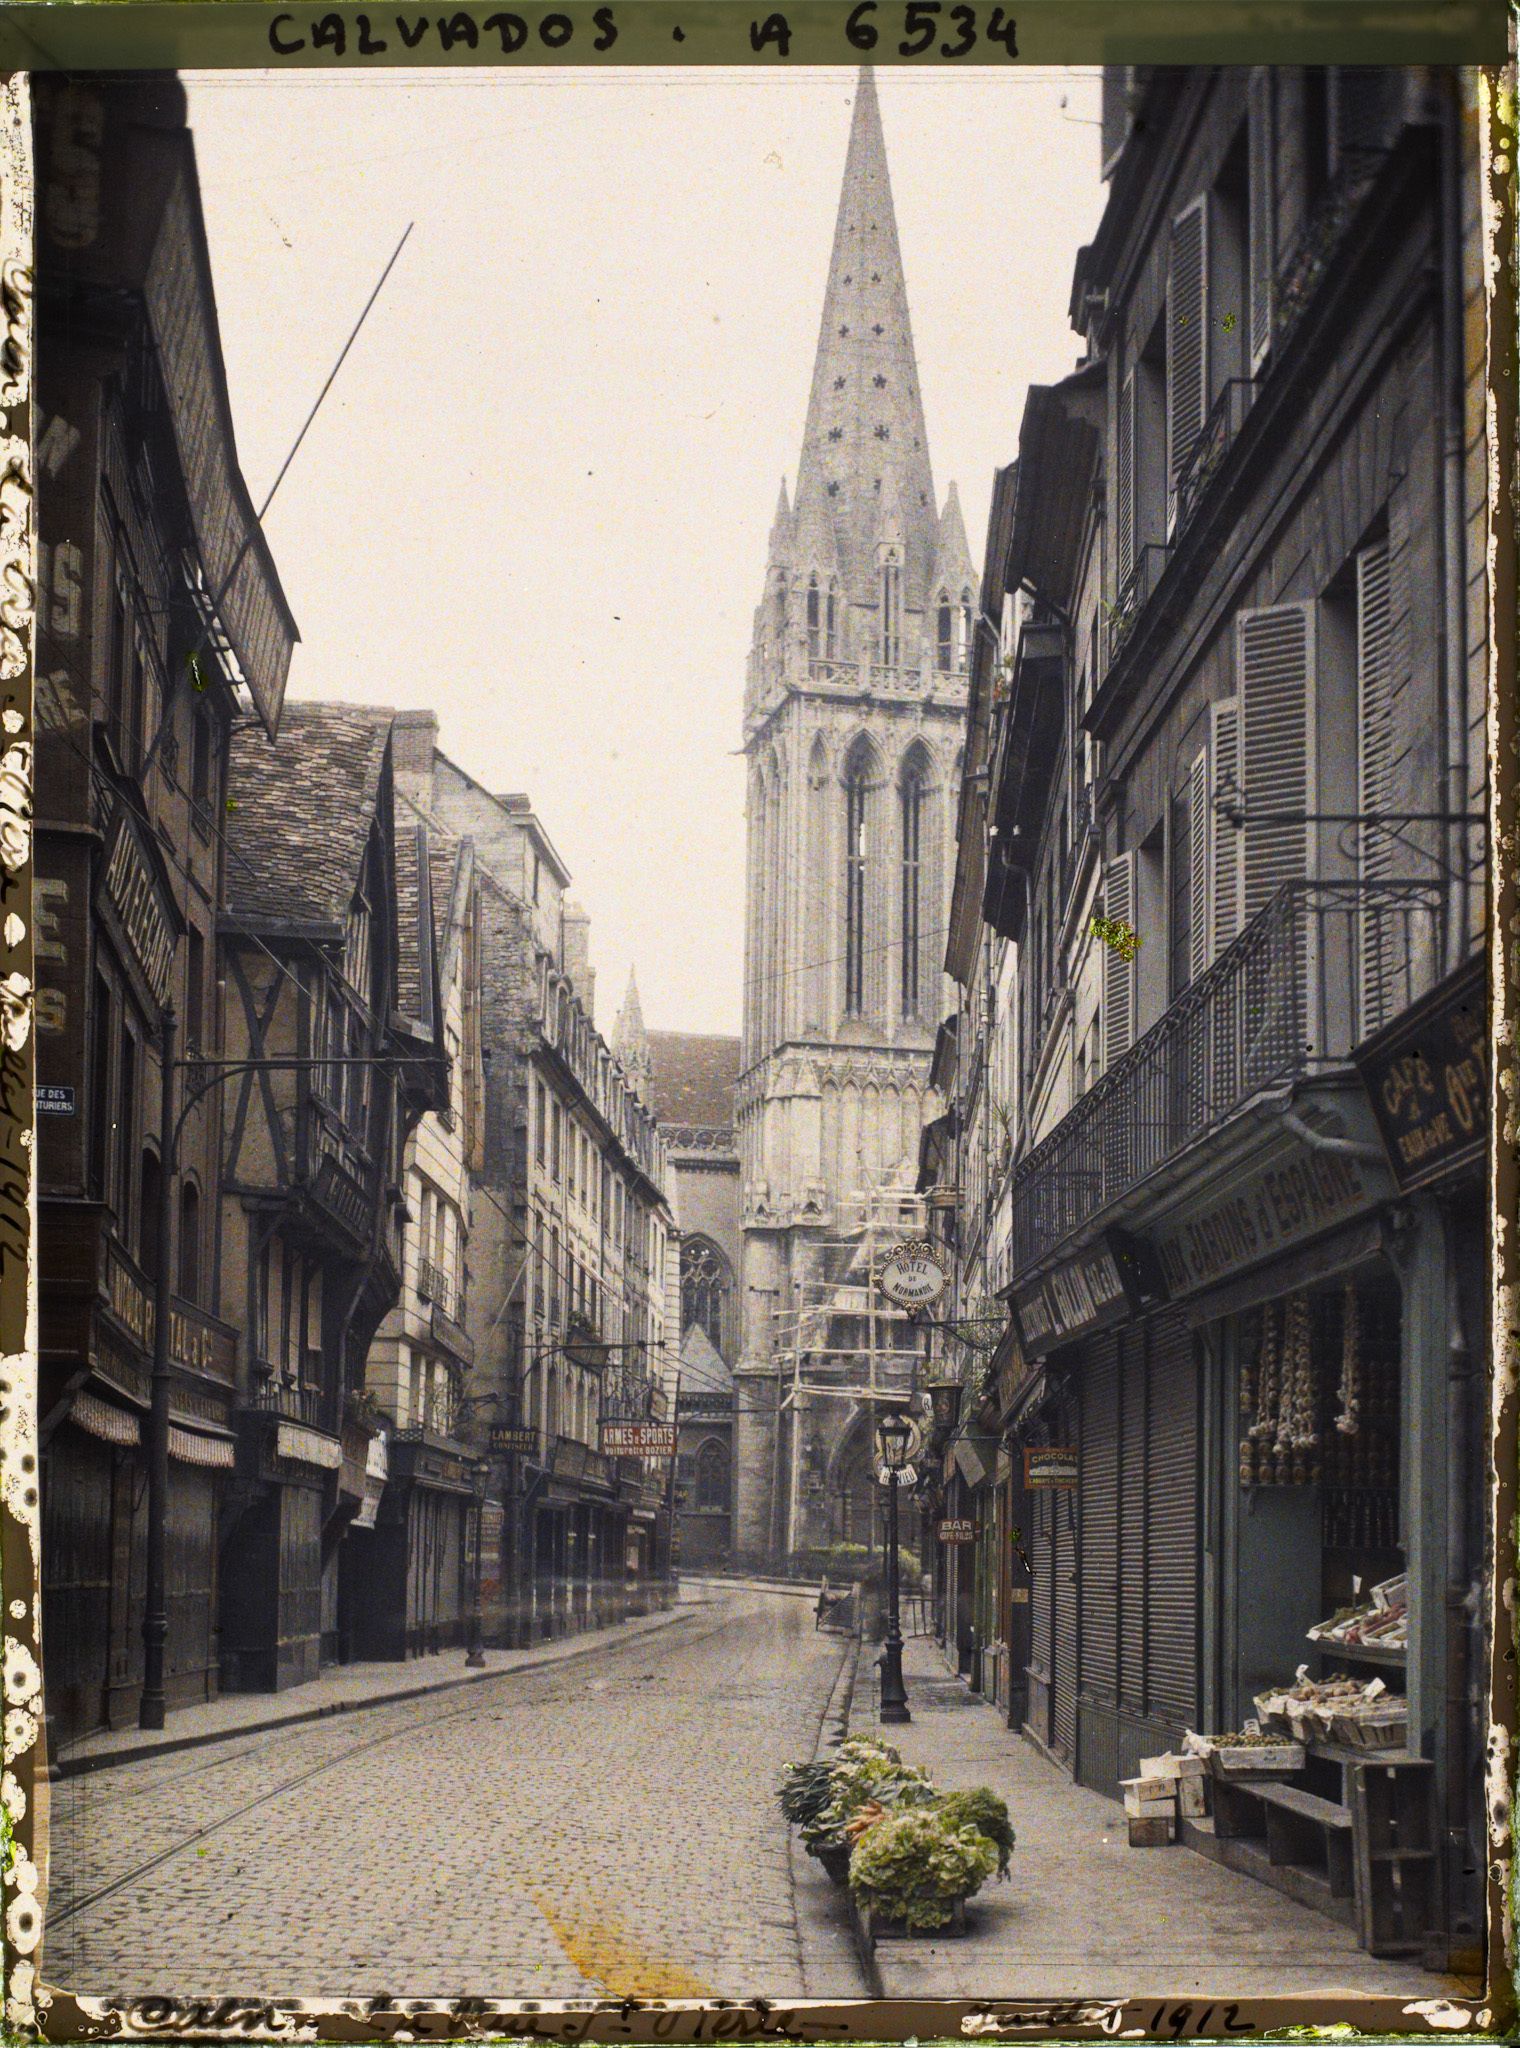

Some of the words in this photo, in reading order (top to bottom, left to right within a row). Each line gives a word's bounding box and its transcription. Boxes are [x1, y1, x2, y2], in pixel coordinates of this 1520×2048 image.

[271, 6, 619, 56] CALVADOS
[751, 15, 794, 56] A
[845, 1, 1024, 58] 6534
[35, 1088, 46, 1098] UE
[48, 1089, 66, 1099] DES
[35, 1100, 73, 1112] TURIERS
[892, 1282, 934, 1297] NORMANDIE
[492, 1430, 536, 1442] LAMBERT
[603, 1427, 634, 1445] ARMES
[640, 1427, 674, 1445] SPORTS
[645, 1445, 673, 1455] BOZIER
[941, 1520, 972, 1530] BAR
[1150, 2003, 1257, 2037] 1912
